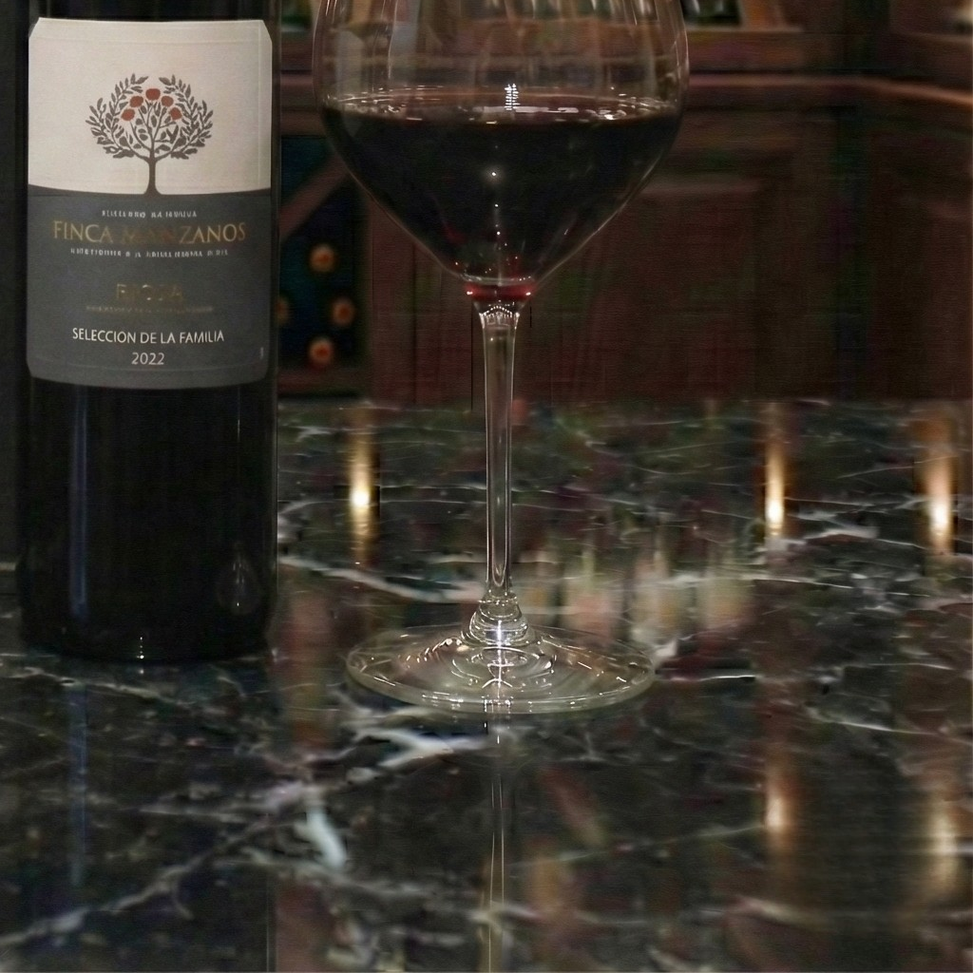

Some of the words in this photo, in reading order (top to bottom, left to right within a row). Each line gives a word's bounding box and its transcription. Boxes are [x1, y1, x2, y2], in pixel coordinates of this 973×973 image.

[52, 220, 114, 244] FINCA
[122, 221, 247, 245] MZANOS
[72, 327, 137, 344] SELECCION
[140, 332, 157, 344] DE
[160, 331, 176, 344] LA
[179, 329, 225, 344] FAMILIA
[131, 351, 165, 366] 2022
